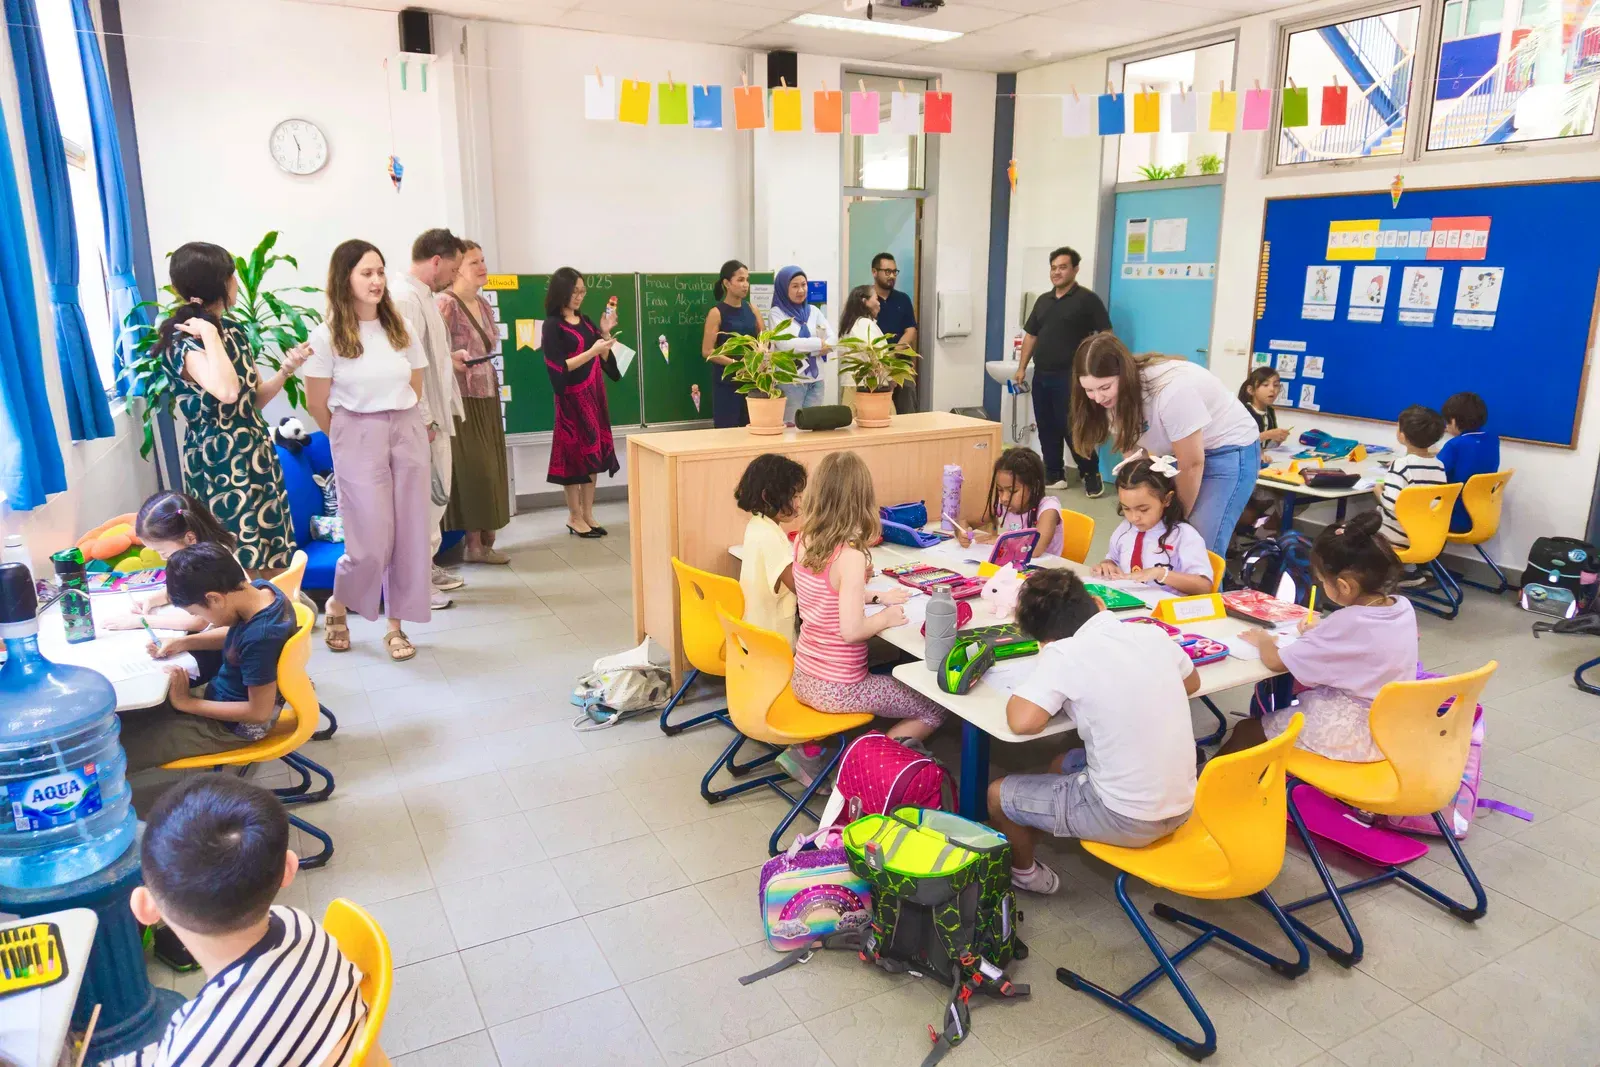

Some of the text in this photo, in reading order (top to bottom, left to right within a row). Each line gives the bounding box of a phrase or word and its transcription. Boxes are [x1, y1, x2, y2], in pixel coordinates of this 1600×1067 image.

[1330, 231, 1487, 247] KLASSENEGELN
[645, 274, 671, 289] Frau
[645, 292, 668, 306] Frau
[648, 310, 672, 325] Frau
[32, 779, 81, 803] AQUA
